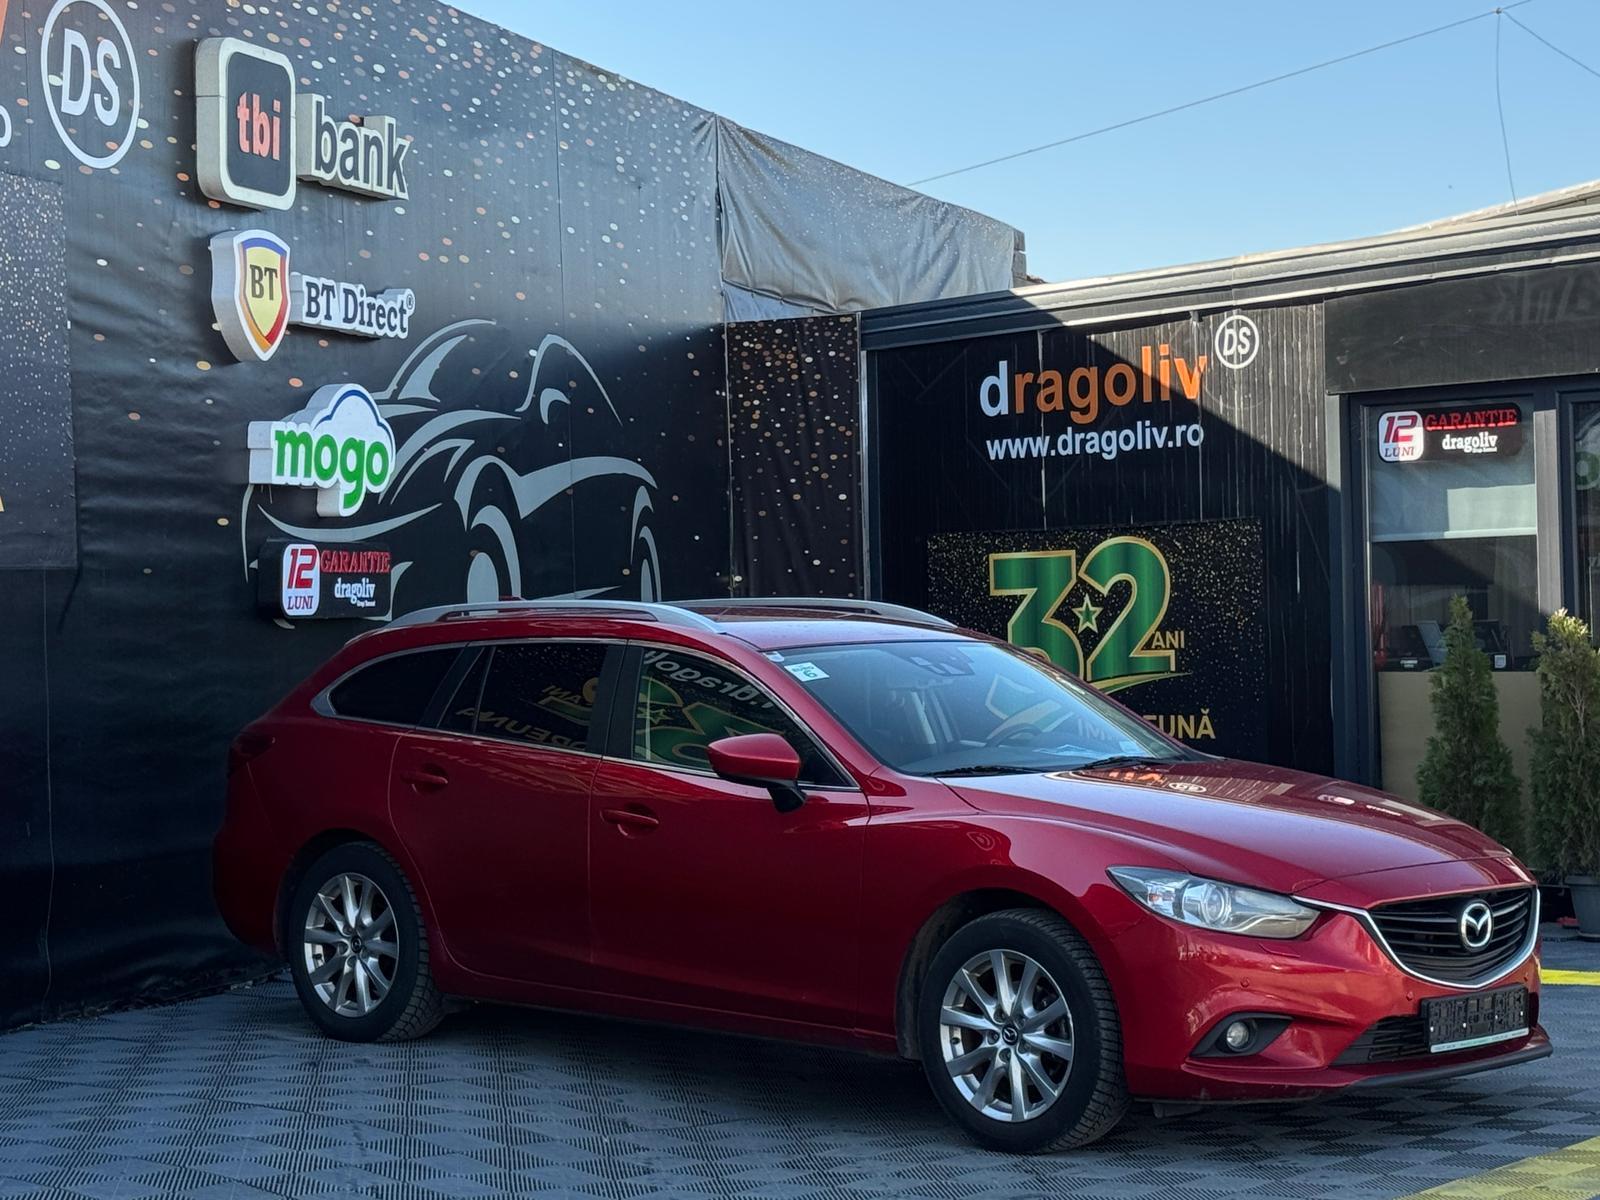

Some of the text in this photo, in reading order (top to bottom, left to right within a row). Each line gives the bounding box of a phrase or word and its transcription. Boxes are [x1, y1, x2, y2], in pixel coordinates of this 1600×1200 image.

[61, 28, 122, 126] DS
[237, 92, 407, 194] tbi bank
[249, 263, 279, 301] BT
[305, 281, 336, 321] BT
[1223, 326, 1251, 356] DS
[979, 344, 1208, 424] dragoliv
[986, 420, 1205, 460] www.dragoliv.ro
[1384, 408, 1517, 443] 12 GARANTIE
[1441, 431, 1498, 454] dragoliv
[275, 429, 389, 510] mogo
[1384, 446, 1415, 458] LUNI
[287, 548, 391, 589] 12 GARANTIE
[287, 595, 314, 610] LUNI
[334, 577, 376, 604] dragoliv
[989, 536, 1176, 682] 32
[1151, 630, 1185, 649] ANI
